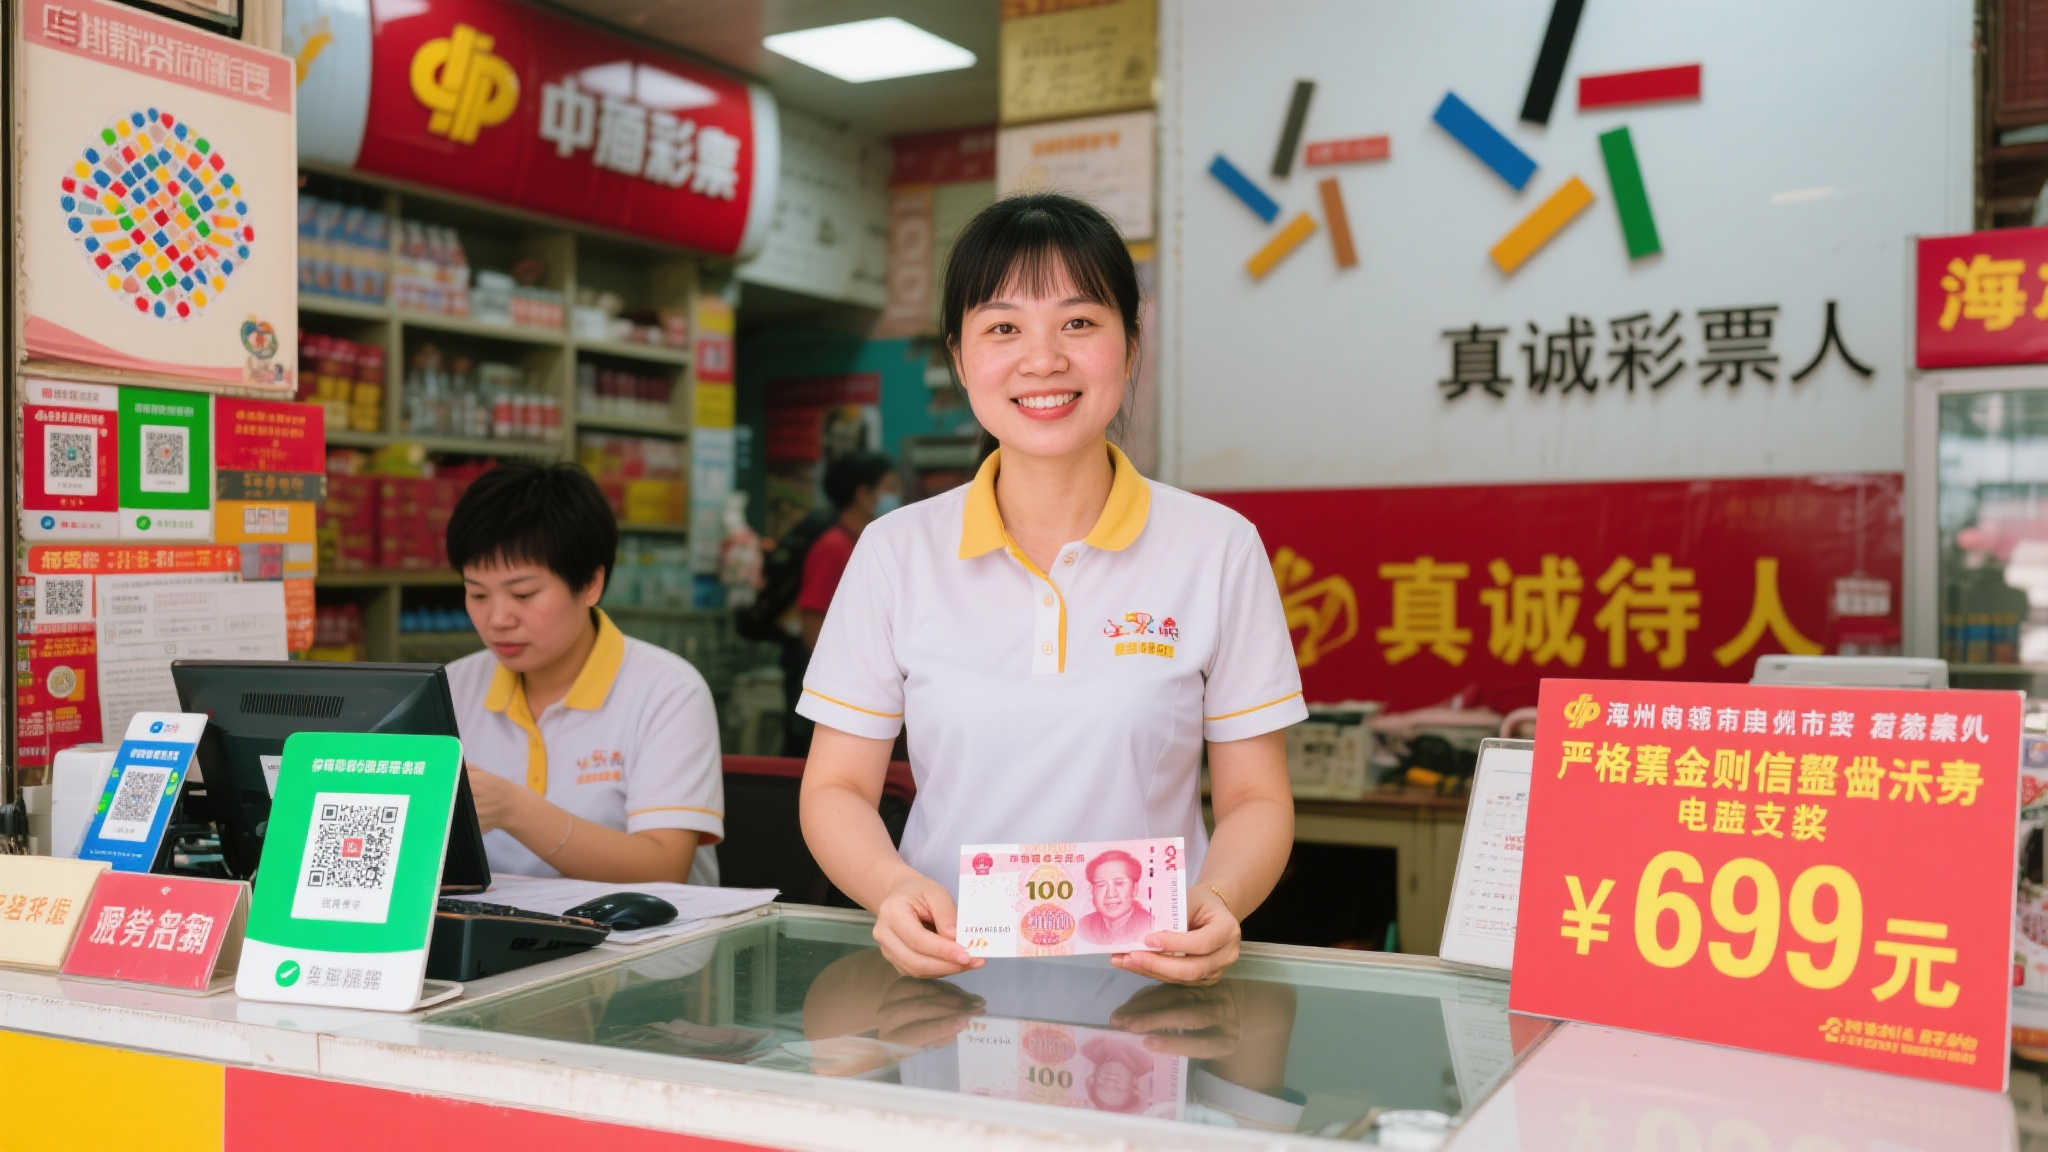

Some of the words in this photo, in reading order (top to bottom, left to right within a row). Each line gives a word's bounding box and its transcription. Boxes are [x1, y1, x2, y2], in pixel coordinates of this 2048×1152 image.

[1938, 253, 2048, 332] 海
[1439, 300, 1876, 401] 真诚彩票人
[1376, 554, 1824, 669] 真诚待人
[1025, 880, 1074, 900] 100
